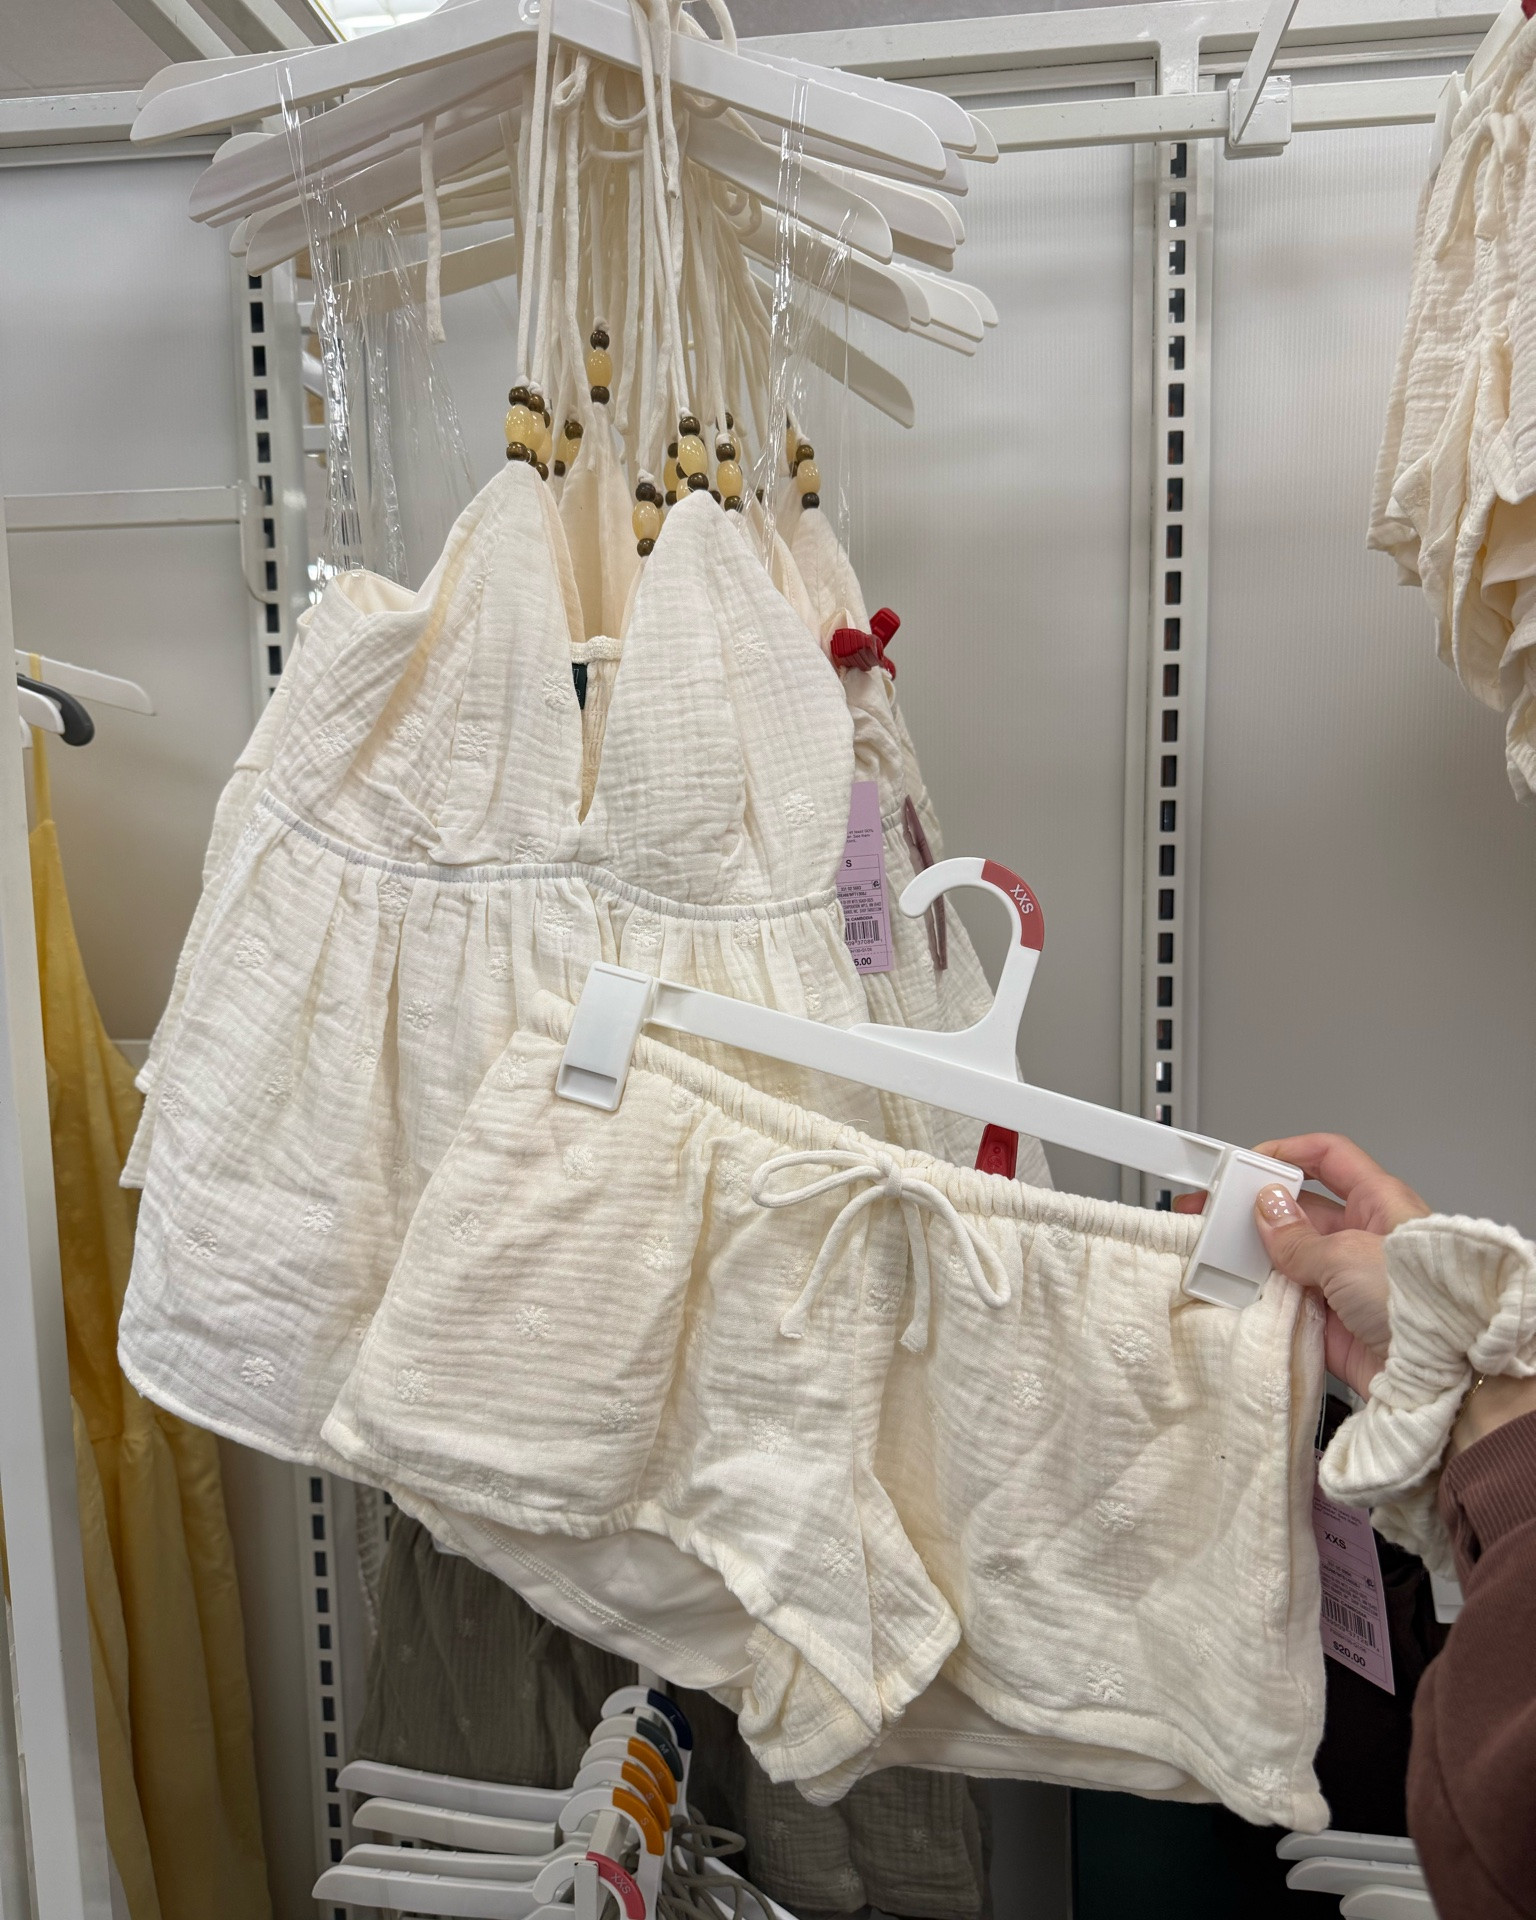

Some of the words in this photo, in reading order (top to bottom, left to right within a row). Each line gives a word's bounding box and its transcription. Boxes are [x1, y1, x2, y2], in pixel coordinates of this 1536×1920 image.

[845, 859, 852, 867] S
[1010, 883, 1034, 914] XXS
[853, 957, 872, 967] 5.00
[1324, 1531, 1347, 1549] XXS
[1333, 1640, 1366, 1667] $20.00
[611, 1872, 631, 1895] XXS
